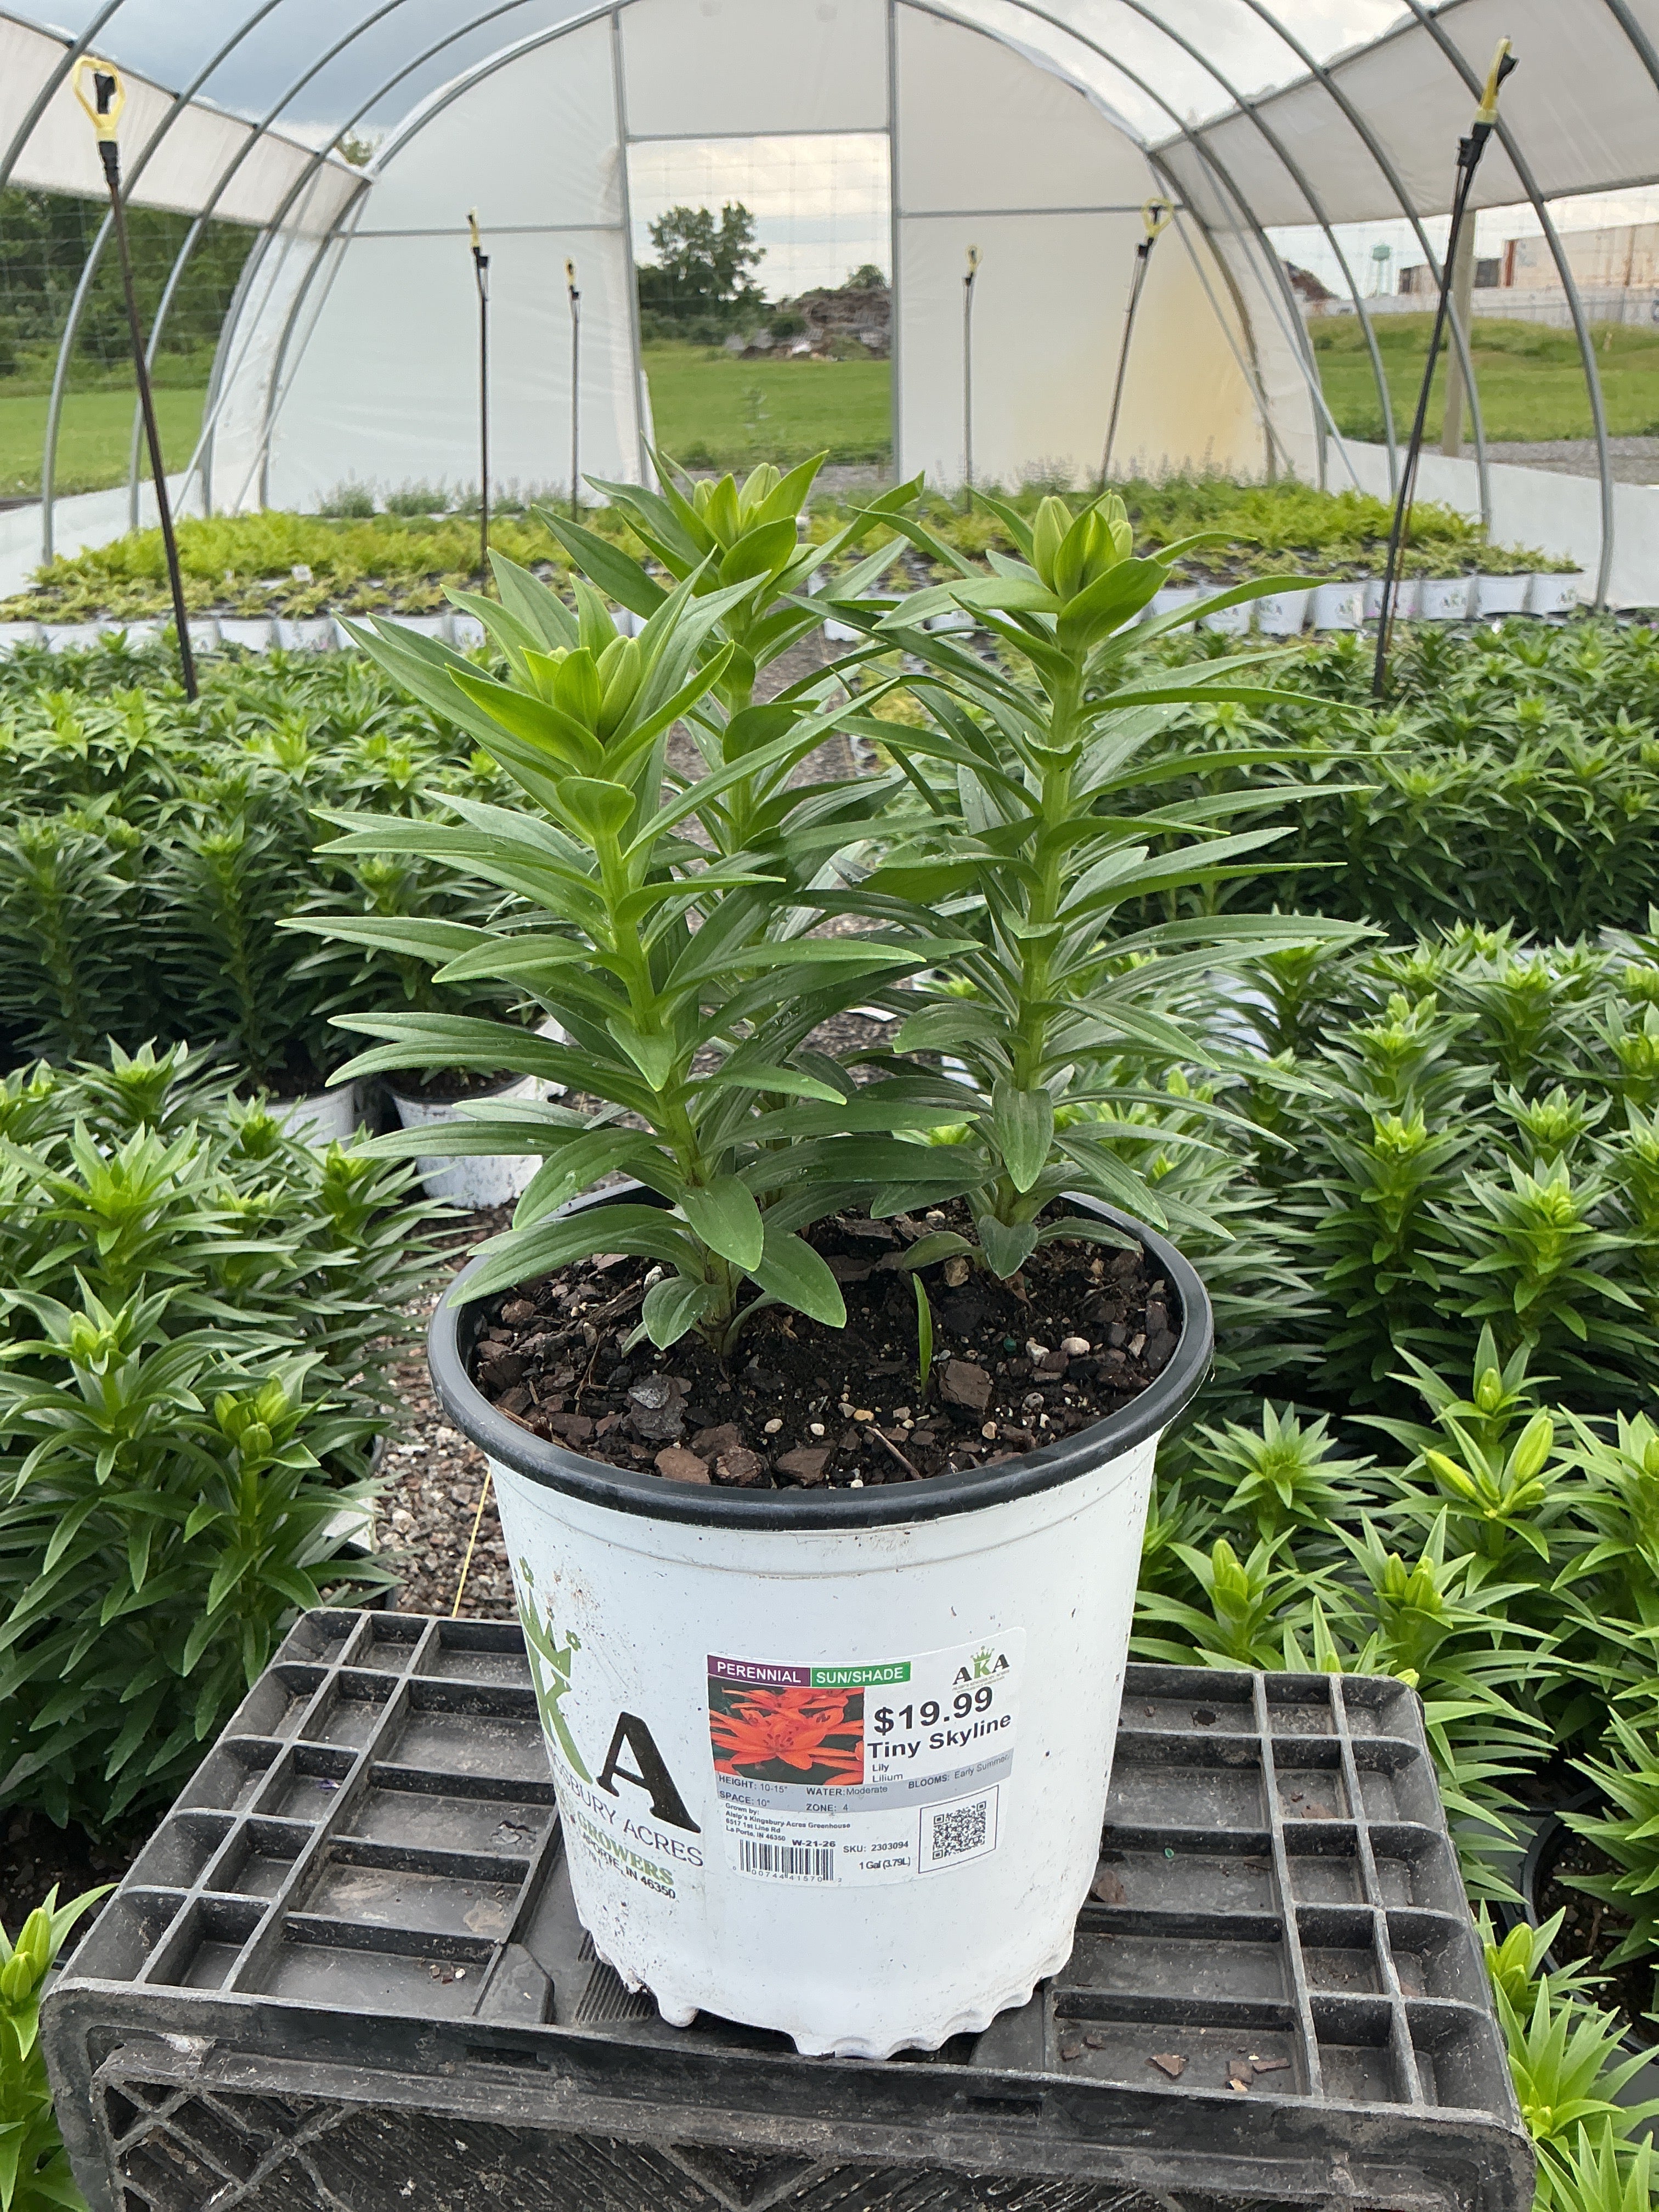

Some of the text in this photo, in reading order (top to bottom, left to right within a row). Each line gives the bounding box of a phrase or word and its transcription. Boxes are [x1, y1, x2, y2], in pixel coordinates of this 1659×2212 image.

[717, 1661, 802, 1683] PERENNIAL
[816, 1667, 904, 1684] SUN/SHADE
[952, 1654, 1010, 1685] AKA
[873, 1686, 992, 1736] $19.99
[867, 1714, 1011, 1759] Tiny Skyline
[872, 1764, 889, 1773] Lily
[908, 1754, 1008, 1789] BLOOMS: Early Summer
[719, 1775, 788, 1793] HEIGHT: 10-15"
[872, 1773, 903, 1782] Lilium
[719, 1790, 770, 1807] SPACE: 10"
[806, 1785, 888, 1796] WATER: Moderate
[725, 1802, 760, 1816] Grown by:
[806, 1803, 849, 1812] ZONE: 4
[725, 1810, 748, 1821] Alsip's
[749, 1815, 785, 1827] Kingsbury
[726, 1818, 741, 1826] 6517
[754, 1824, 769, 1832] Line
[623, 1818, 704, 1867] ACRES
[736, 1827, 755, 1837] Porte,
[766, 1833, 786, 1842] 46350
[577, 1811, 674, 1886] GROWERS
[791, 1839, 836, 1848] W-21-26
[843, 1841, 909, 1853] SKU: 2303094
[859, 1861, 864, 1870] 1
[866, 1860, 882, 1870] Gal
[625, 1865, 637, 1881] IN
[640, 1875, 676, 1900] 46350
